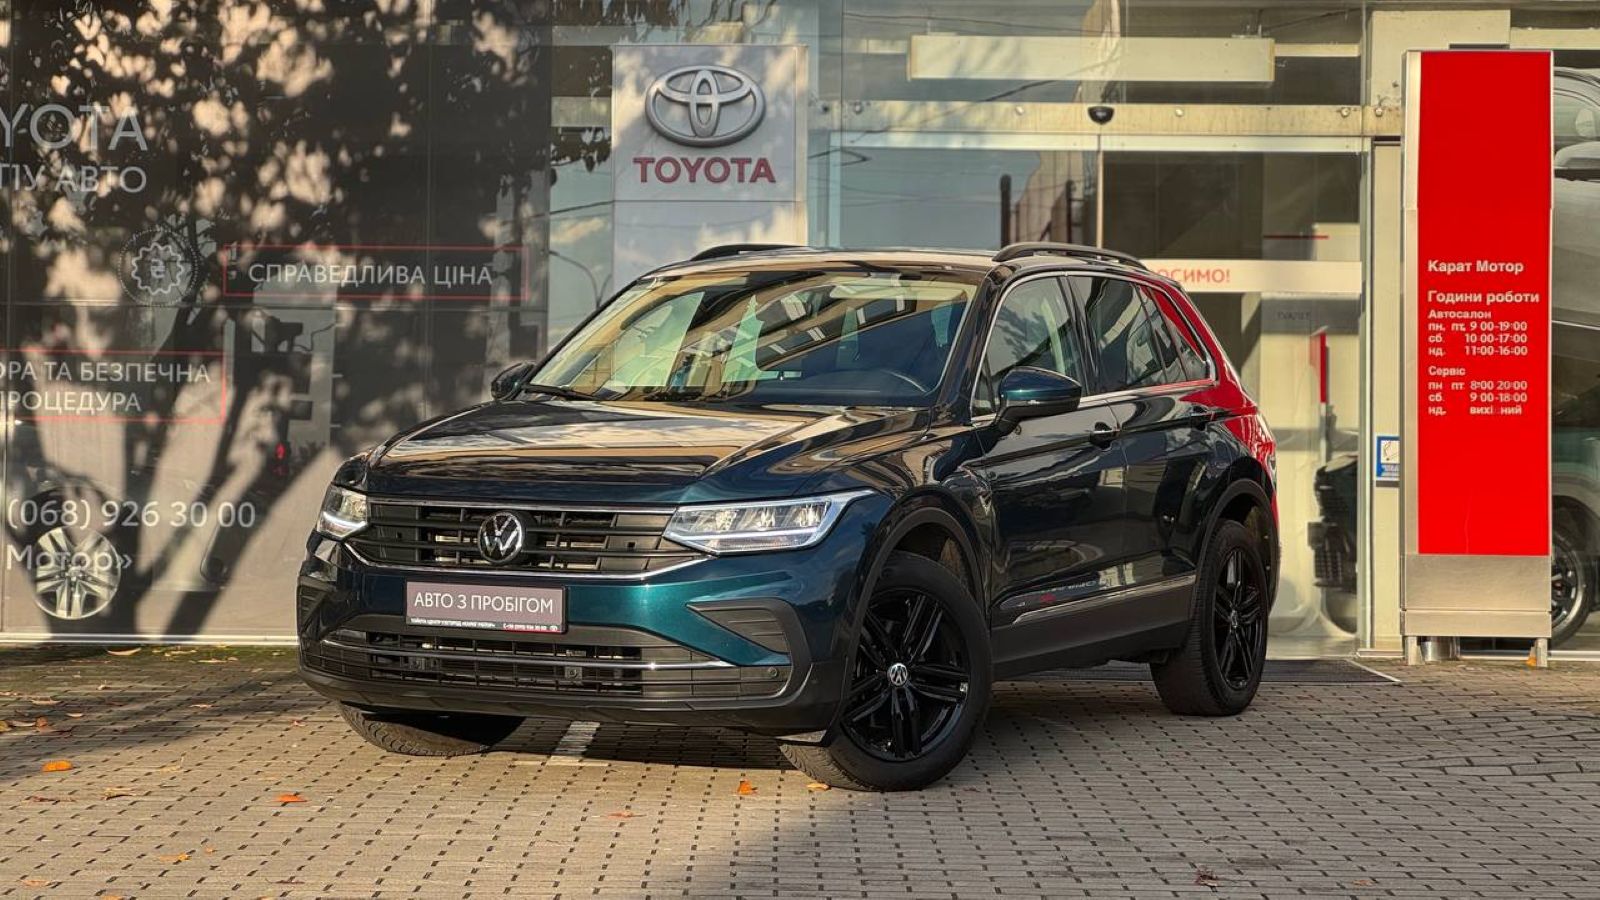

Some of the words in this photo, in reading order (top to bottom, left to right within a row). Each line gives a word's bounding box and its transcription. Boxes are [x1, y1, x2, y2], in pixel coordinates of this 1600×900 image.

[54, 165, 147, 193] АВТО
[633, 157, 776, 183] TOYOTA
[248, 264, 426, 288] СПРАВЕДЛИВА
[434, 265, 493, 288] ЦІНА
[1428, 260, 1472, 275] Карат
[1476, 260, 1524, 275] Мотор
[1428, 290, 1482, 304] Години
[1486, 290, 1540, 305] роботи
[1428, 309, 1491, 319] Автосалон
[44, 362, 72, 381] ТА
[80, 362, 211, 383] БЕЗПЕЧНА
[1428, 366, 1466, 377] Сервіс
[7, 500, 91, 529] (068)
[101, 501, 159, 528] 926
[170, 502, 207, 528] 30
[217, 502, 256, 528] 00
[414, 592, 453, 609] АВТО
[471, 594, 553, 614] ПРОБІГОМ
